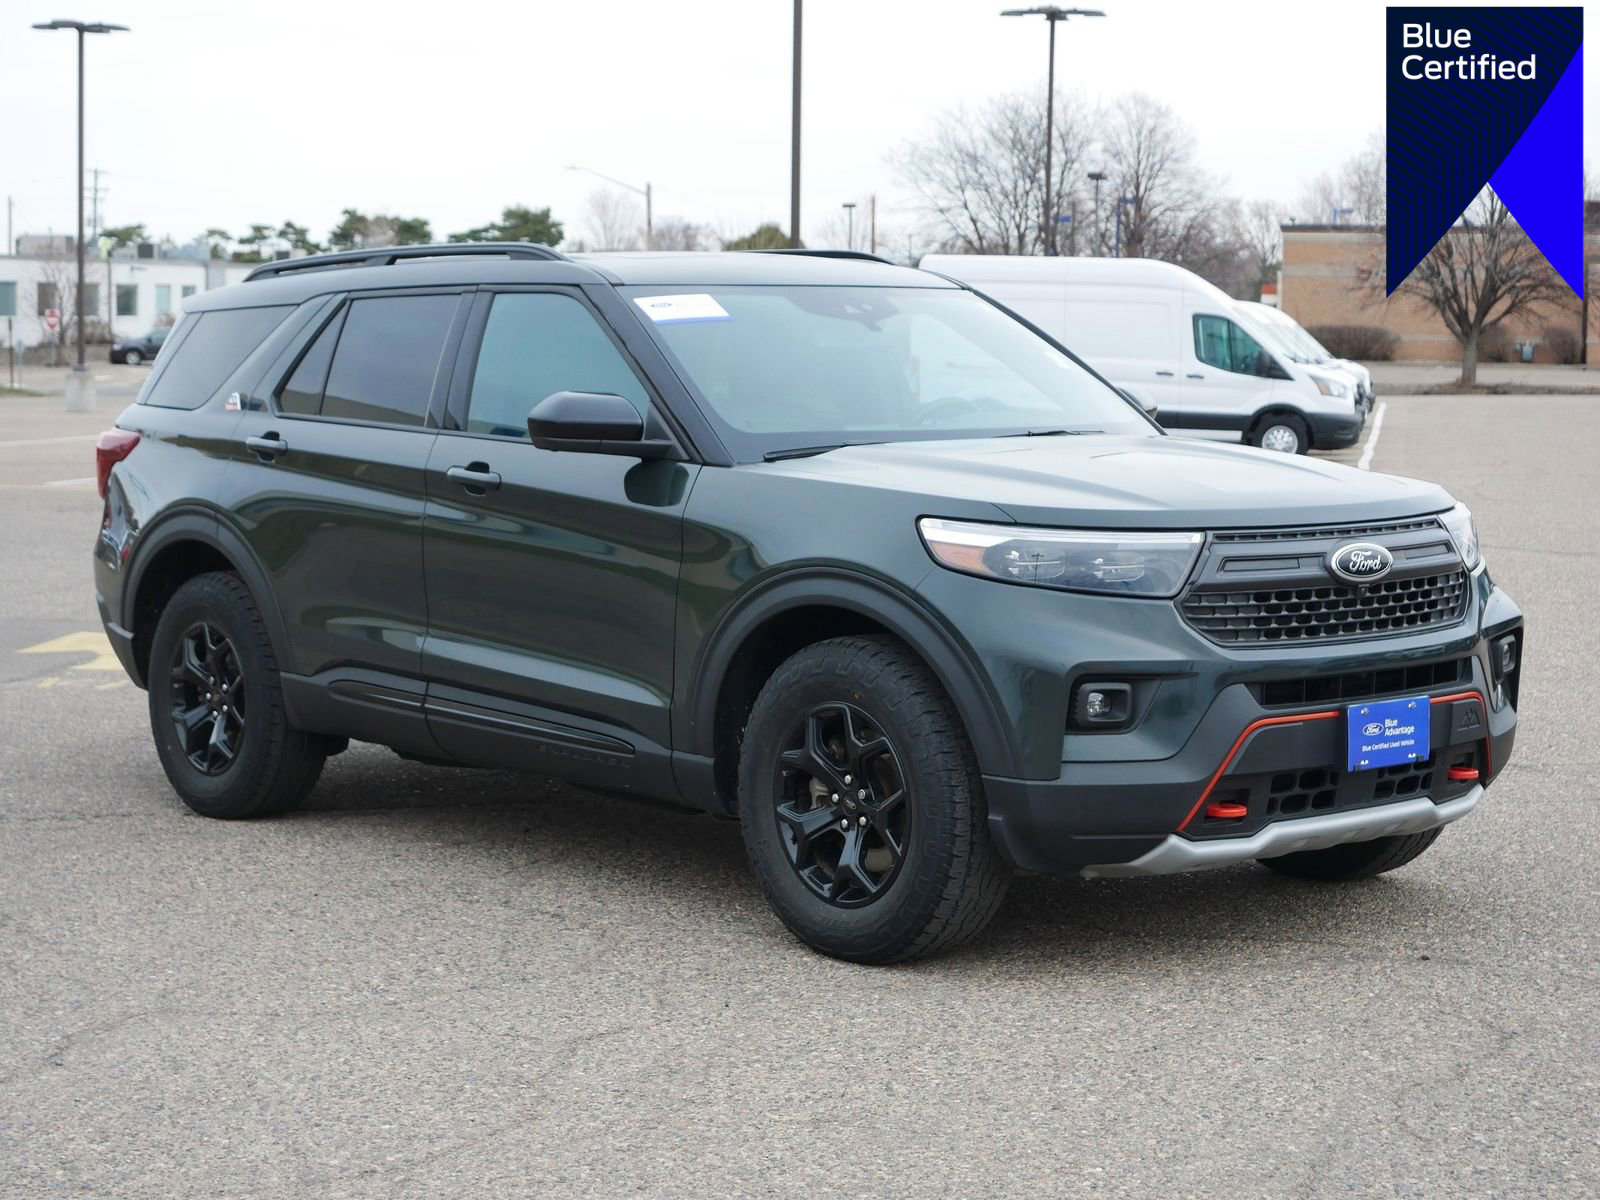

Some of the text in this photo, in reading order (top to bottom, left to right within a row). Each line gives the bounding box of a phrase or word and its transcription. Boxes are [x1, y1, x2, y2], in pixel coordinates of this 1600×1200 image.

[1349, 550, 1382, 572] Ford
[1384, 718, 1398, 727] Blue
[1384, 725, 1415, 736] Advantage
[1371, 742, 1389, 750] Certified
